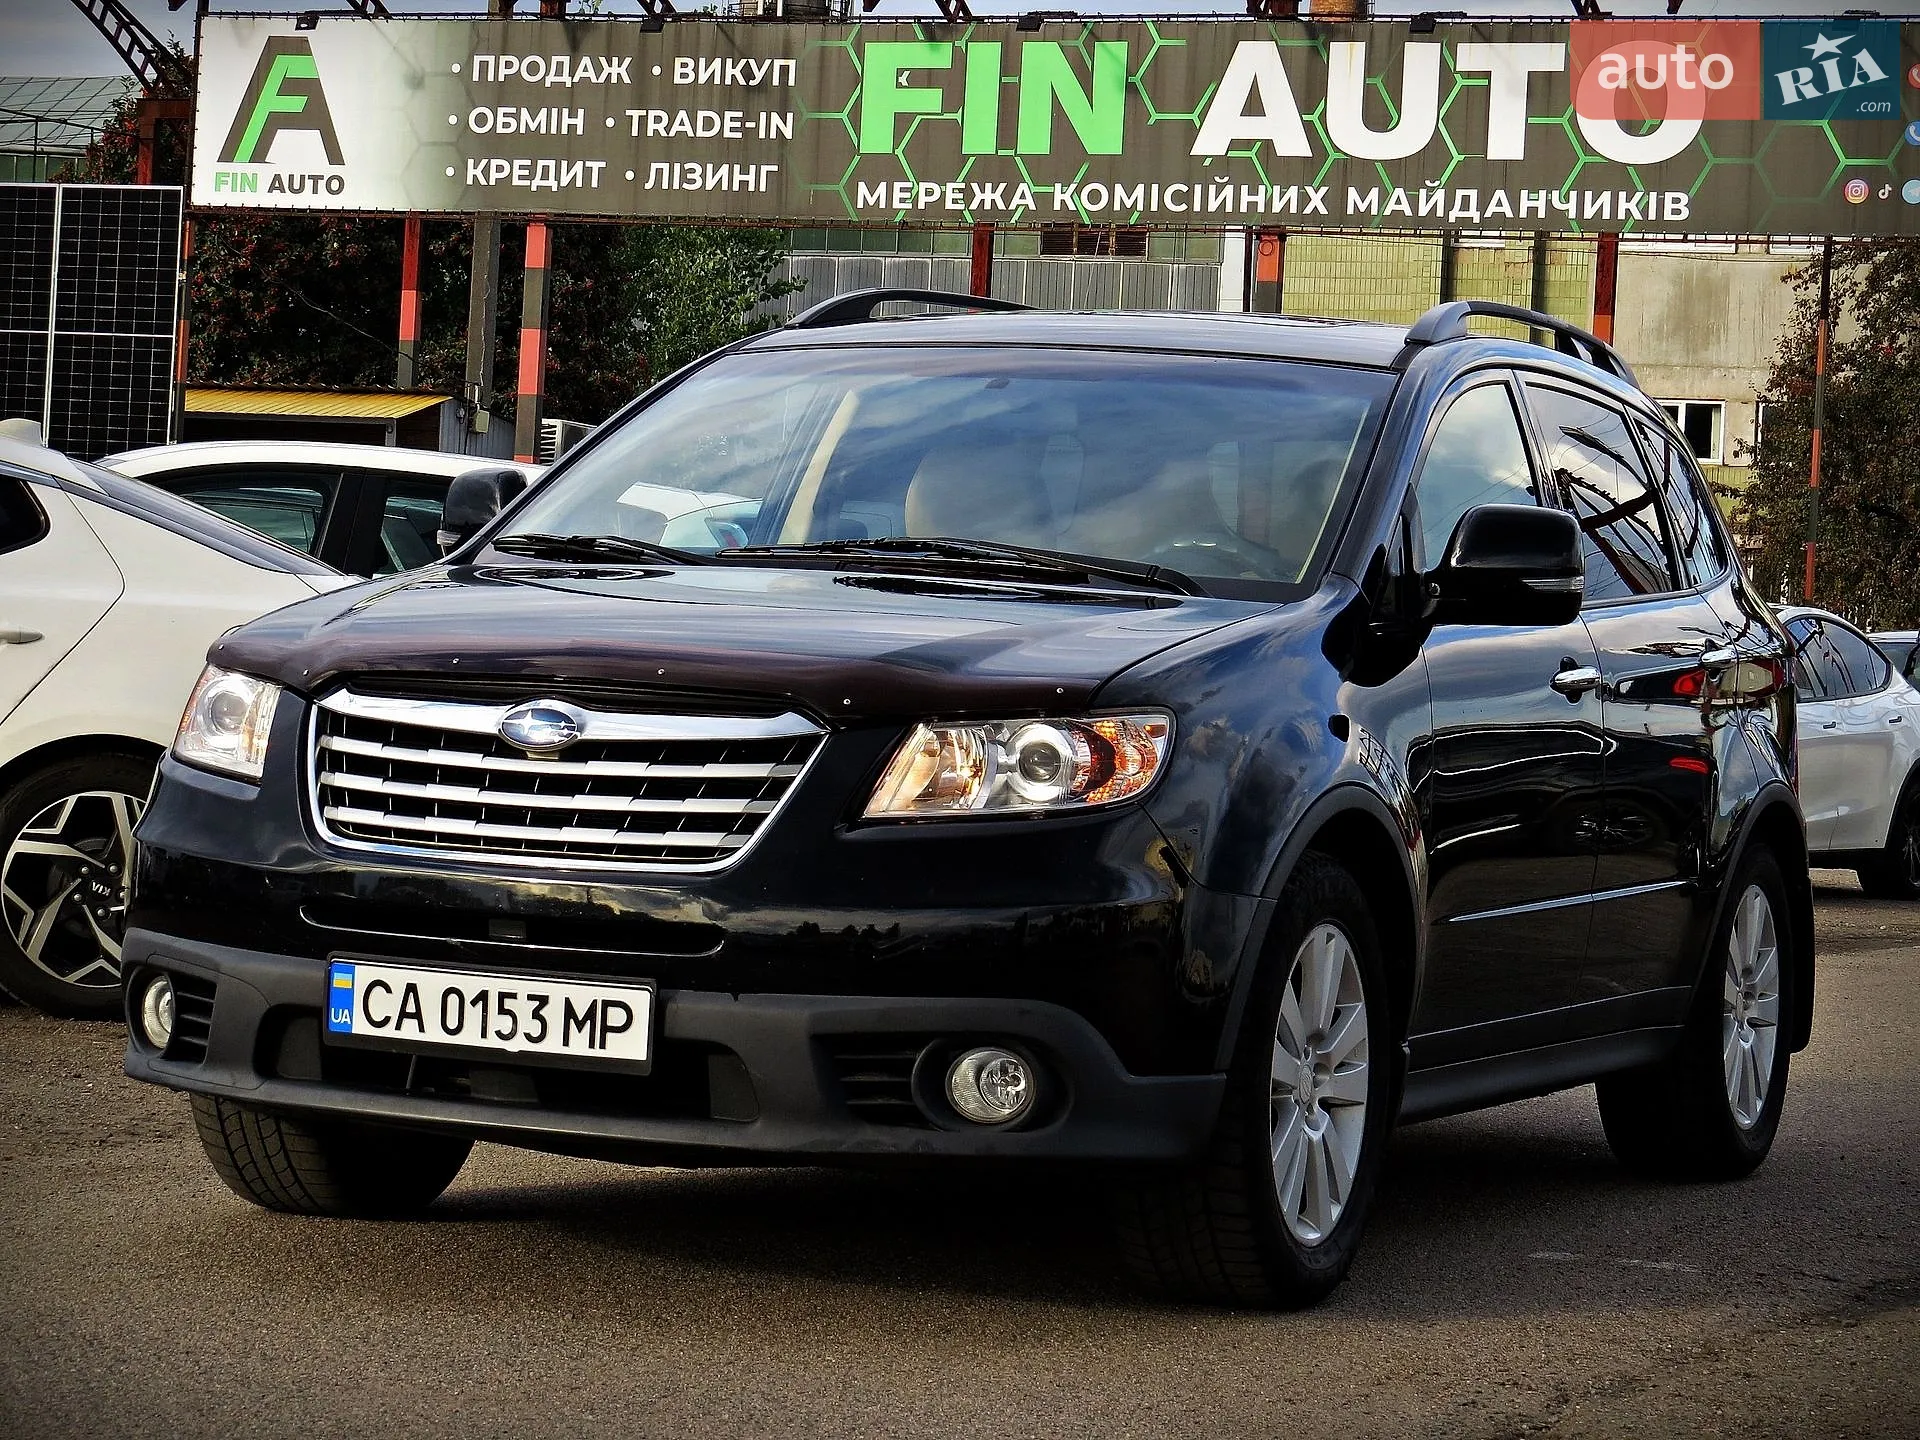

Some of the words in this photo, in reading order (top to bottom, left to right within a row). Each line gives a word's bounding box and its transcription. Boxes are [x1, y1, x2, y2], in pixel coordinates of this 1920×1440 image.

[471, 55, 633, 87] ПРОДАЖ
[673, 57, 796, 87] ВИКУП
[859, 42, 1128, 156] FIN
[1190, 41, 1706, 165] AUTO
[468, 106, 585, 136] ОБМІН
[625, 109, 794, 140] TRADE-IN
[214, 172, 258, 193] FIN
[267, 173, 345, 195] AUTO
[466, 159, 606, 192] КРЕДИТ
[644, 163, 779, 193] ЛІЗИНГ
[857, 182, 1036, 211] МЕРЕЖА
[1053, 176, 1328, 216] КОМІСІЙНИХ
[1346, 180, 1691, 222] МАЙДАНЧИКІВ
[91, 881, 111, 896] KIA
[331, 1007, 352, 1025] UA
[362, 979, 426, 1034] CA
[440, 986, 550, 1044] 0153
[562, 996, 634, 1050] MP
